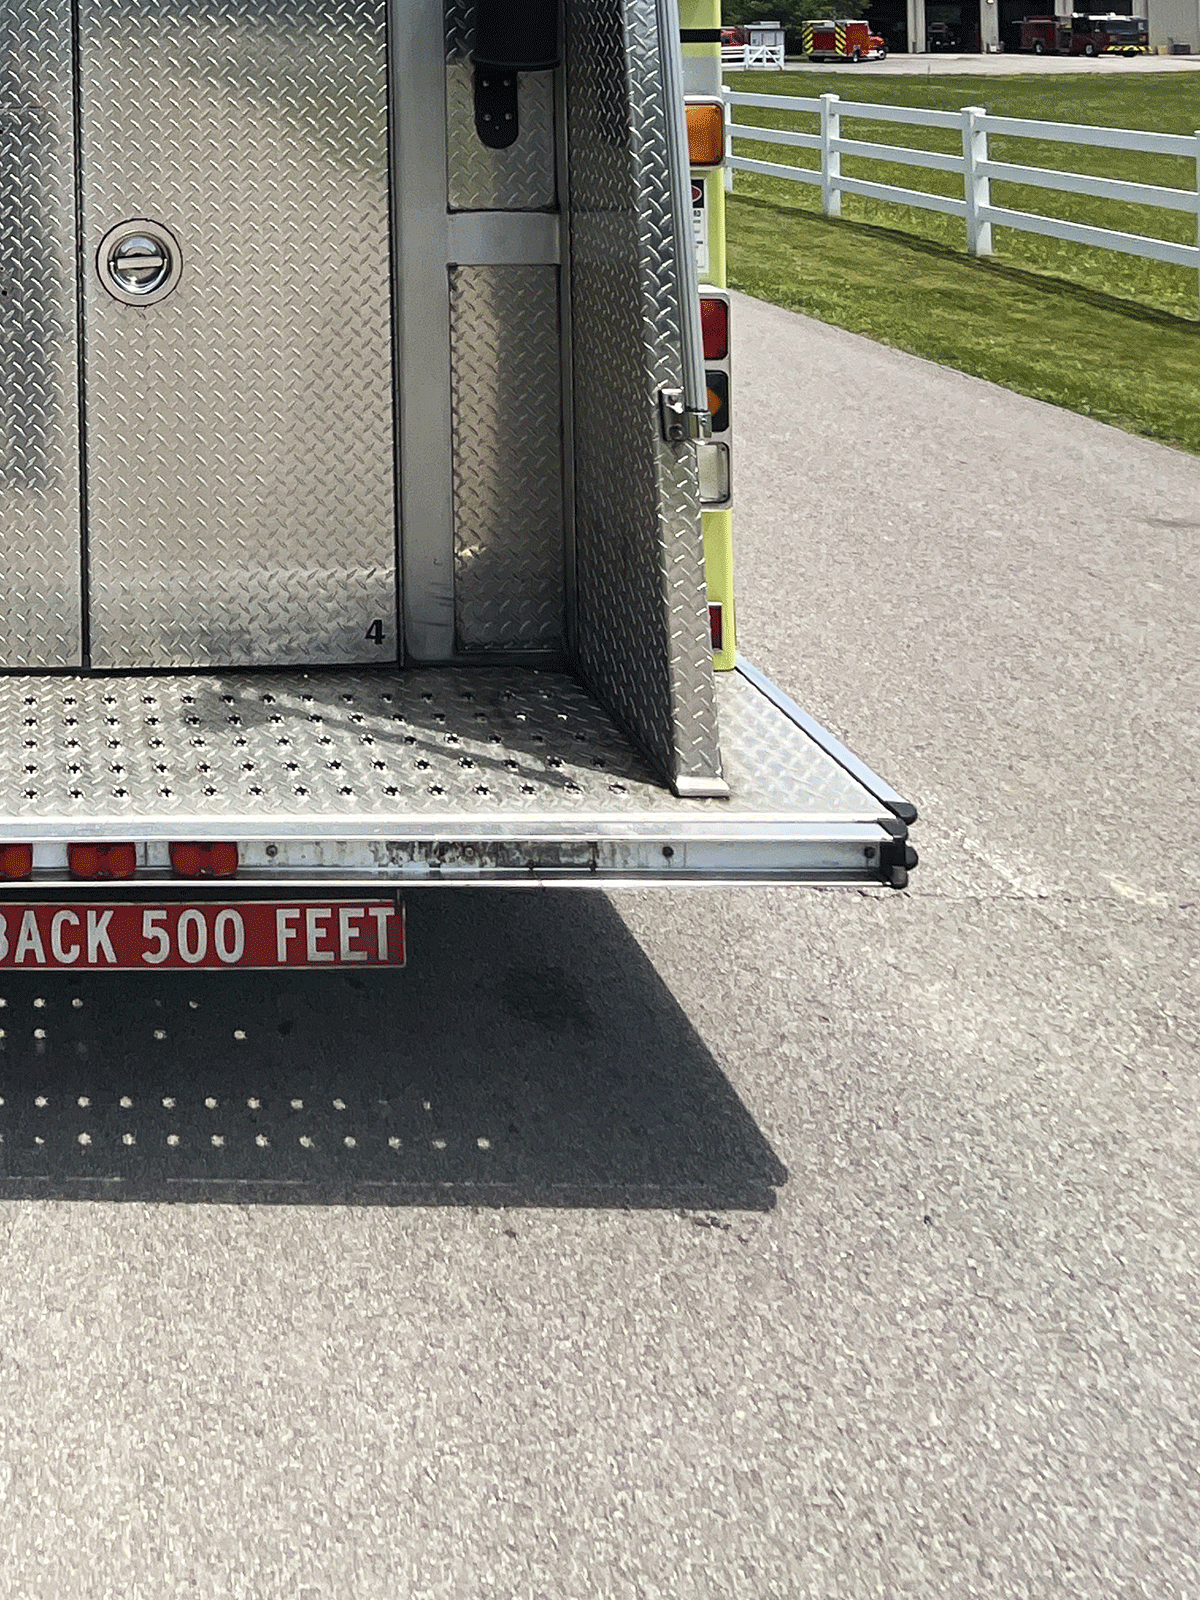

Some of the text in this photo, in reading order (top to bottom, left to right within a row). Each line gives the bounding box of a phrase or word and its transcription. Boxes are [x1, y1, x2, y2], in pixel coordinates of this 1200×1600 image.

[364, 619, 386, 645] 4
[141, 908, 246, 965] 500
[276, 906, 397, 963] FEET
